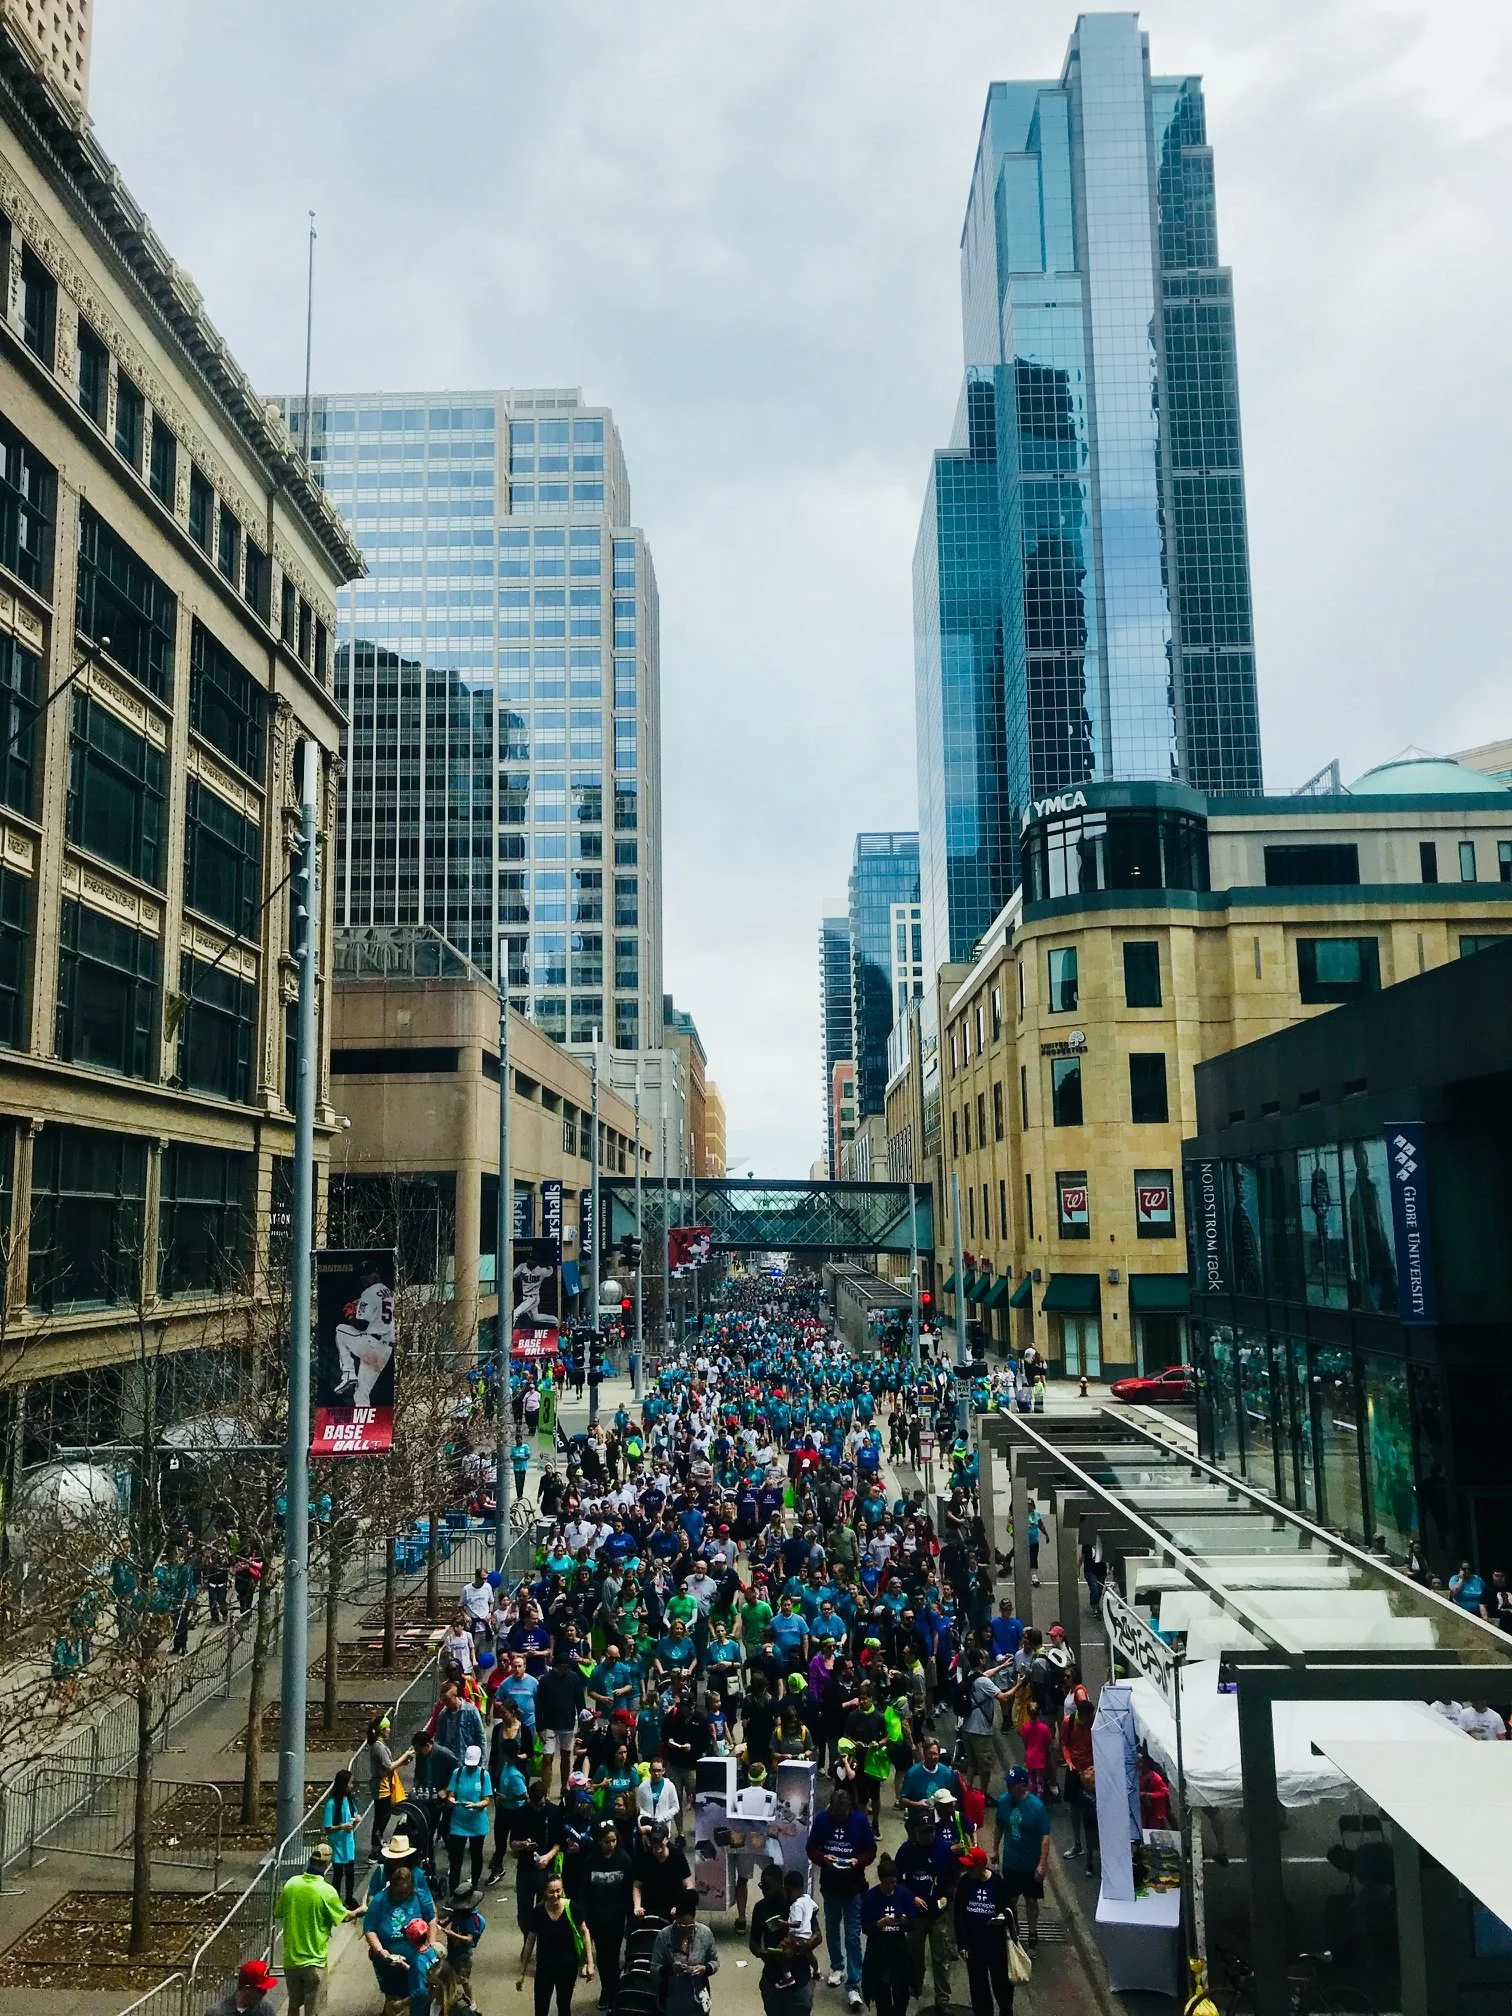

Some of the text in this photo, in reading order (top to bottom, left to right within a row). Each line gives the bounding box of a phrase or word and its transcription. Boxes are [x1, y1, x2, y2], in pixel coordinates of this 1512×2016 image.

[1033, 790, 1087, 817] YMCA
[545, 1184, 561, 1261] arshalls
[1201, 1163, 1224, 1291] NORDSTROM rack
[1403, 1186, 1425, 1316] GLOBE UNIVERSITY
[534, 1329, 548, 1339] WE
[517, 1339, 542, 1349] BASE
[524, 1347, 546, 1356] BALL
[352, 1408, 376, 1424] WE
[323, 1424, 364, 1440] BASE
[332, 1440, 370, 1452] BALL
